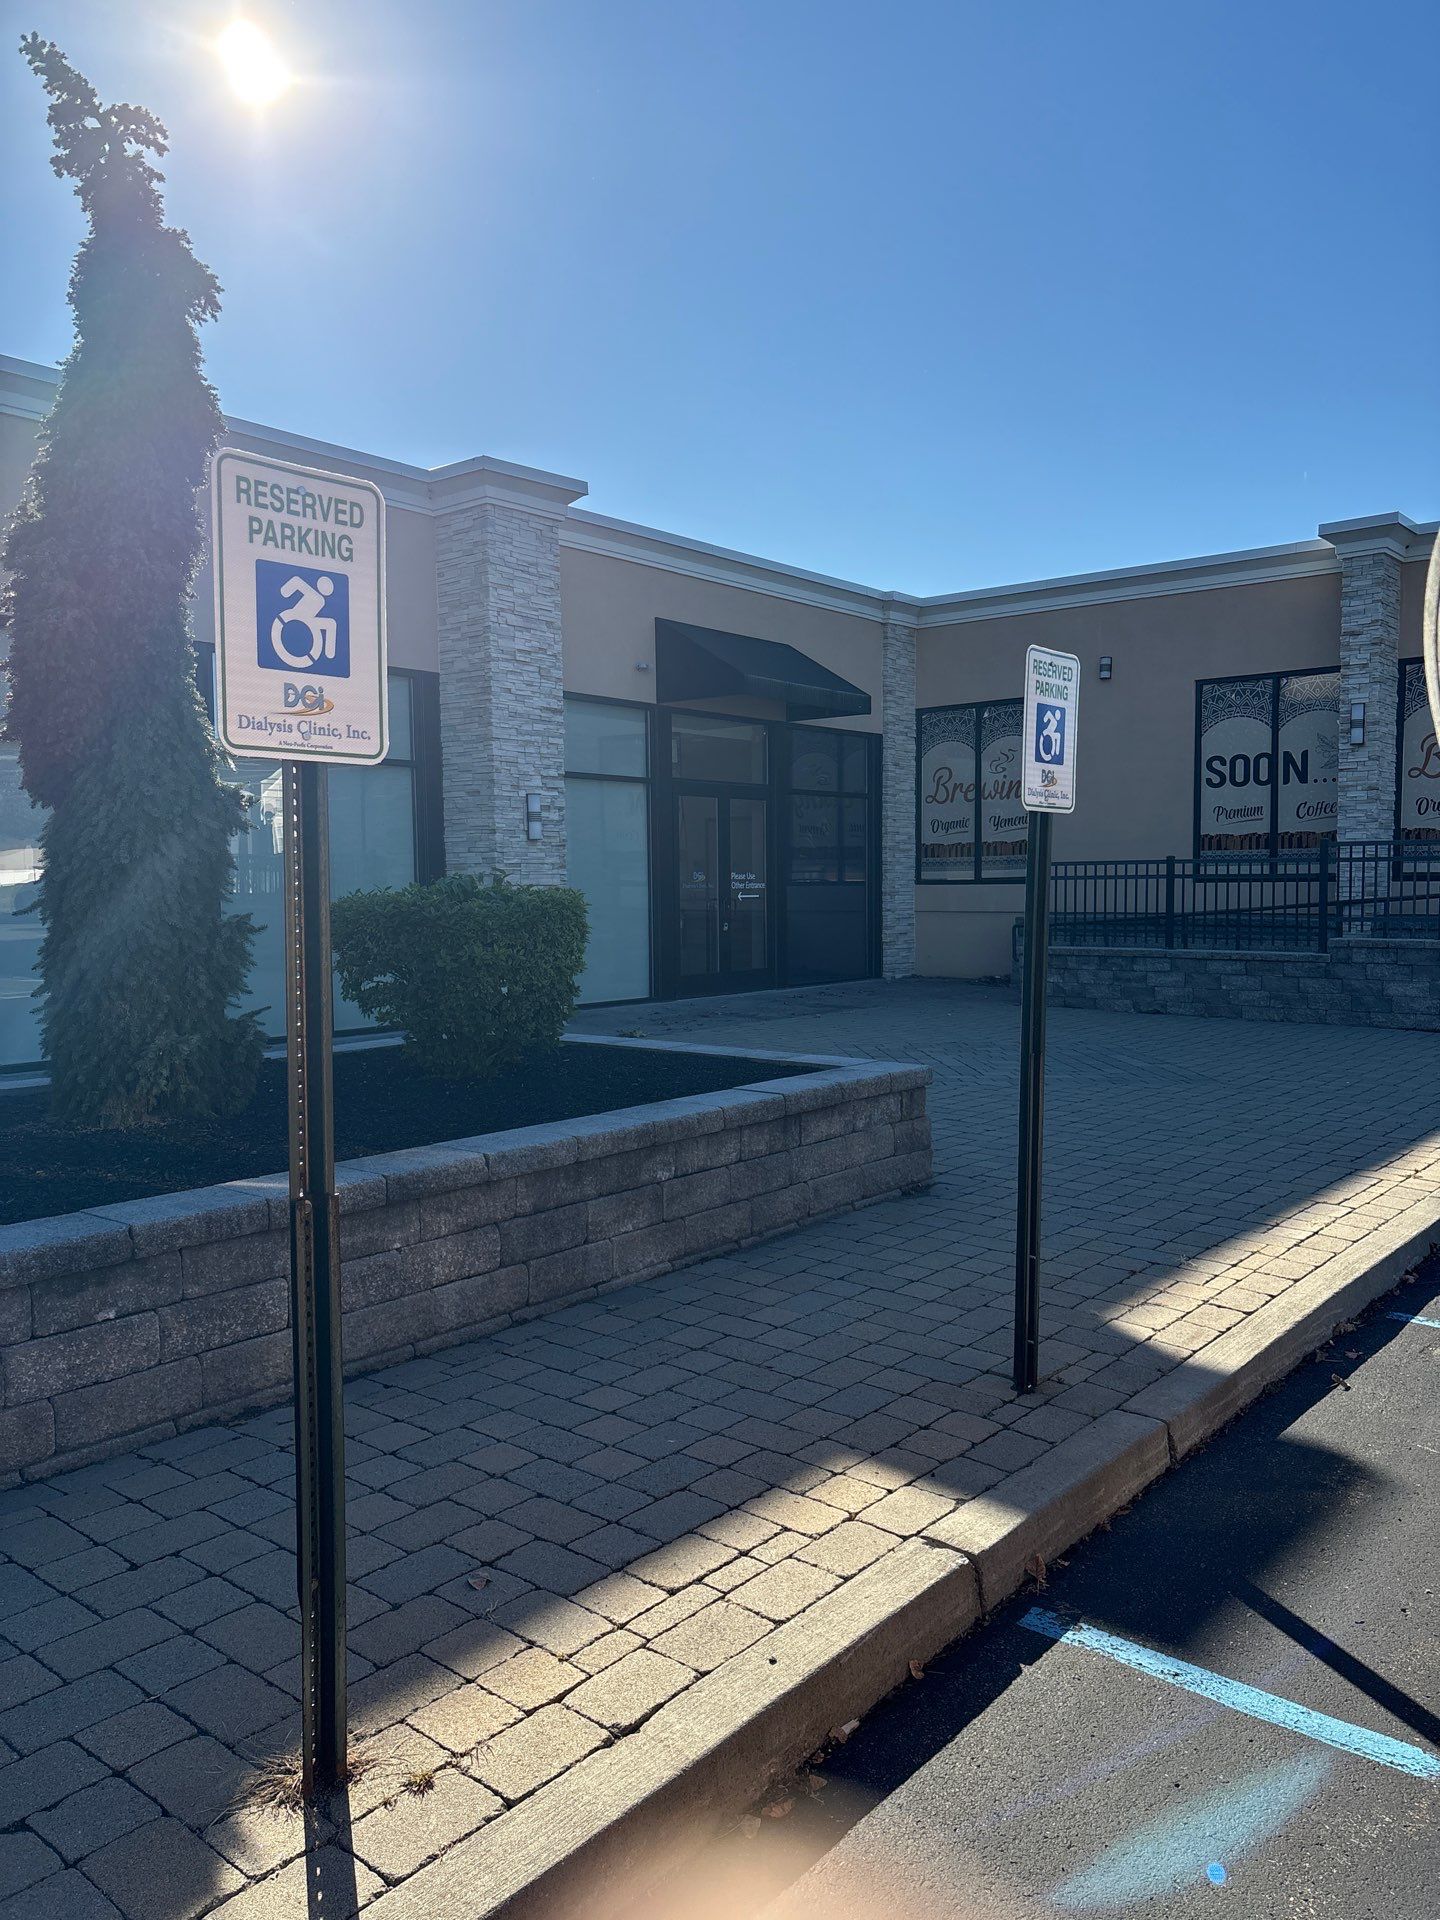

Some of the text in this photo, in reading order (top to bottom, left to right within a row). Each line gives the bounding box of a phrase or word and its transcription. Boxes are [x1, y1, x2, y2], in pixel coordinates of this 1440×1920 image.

[235, 475, 365, 529] RESERVED
[248, 515, 354, 563] PARKING
[1032, 658, 1073, 683] RESERVED
[1035, 679, 1069, 701] PARKING
[237, 714, 371, 741] Dialysis Clinic, Inc.
[925, 766, 1022, 805] Brewin
[930, 813, 1029, 834] Organic Yemeni
[1213, 801, 1337, 823] Premium Coffee
[730, 871, 756, 880] Please Use
[730, 881, 767, 889] Other Entrance
